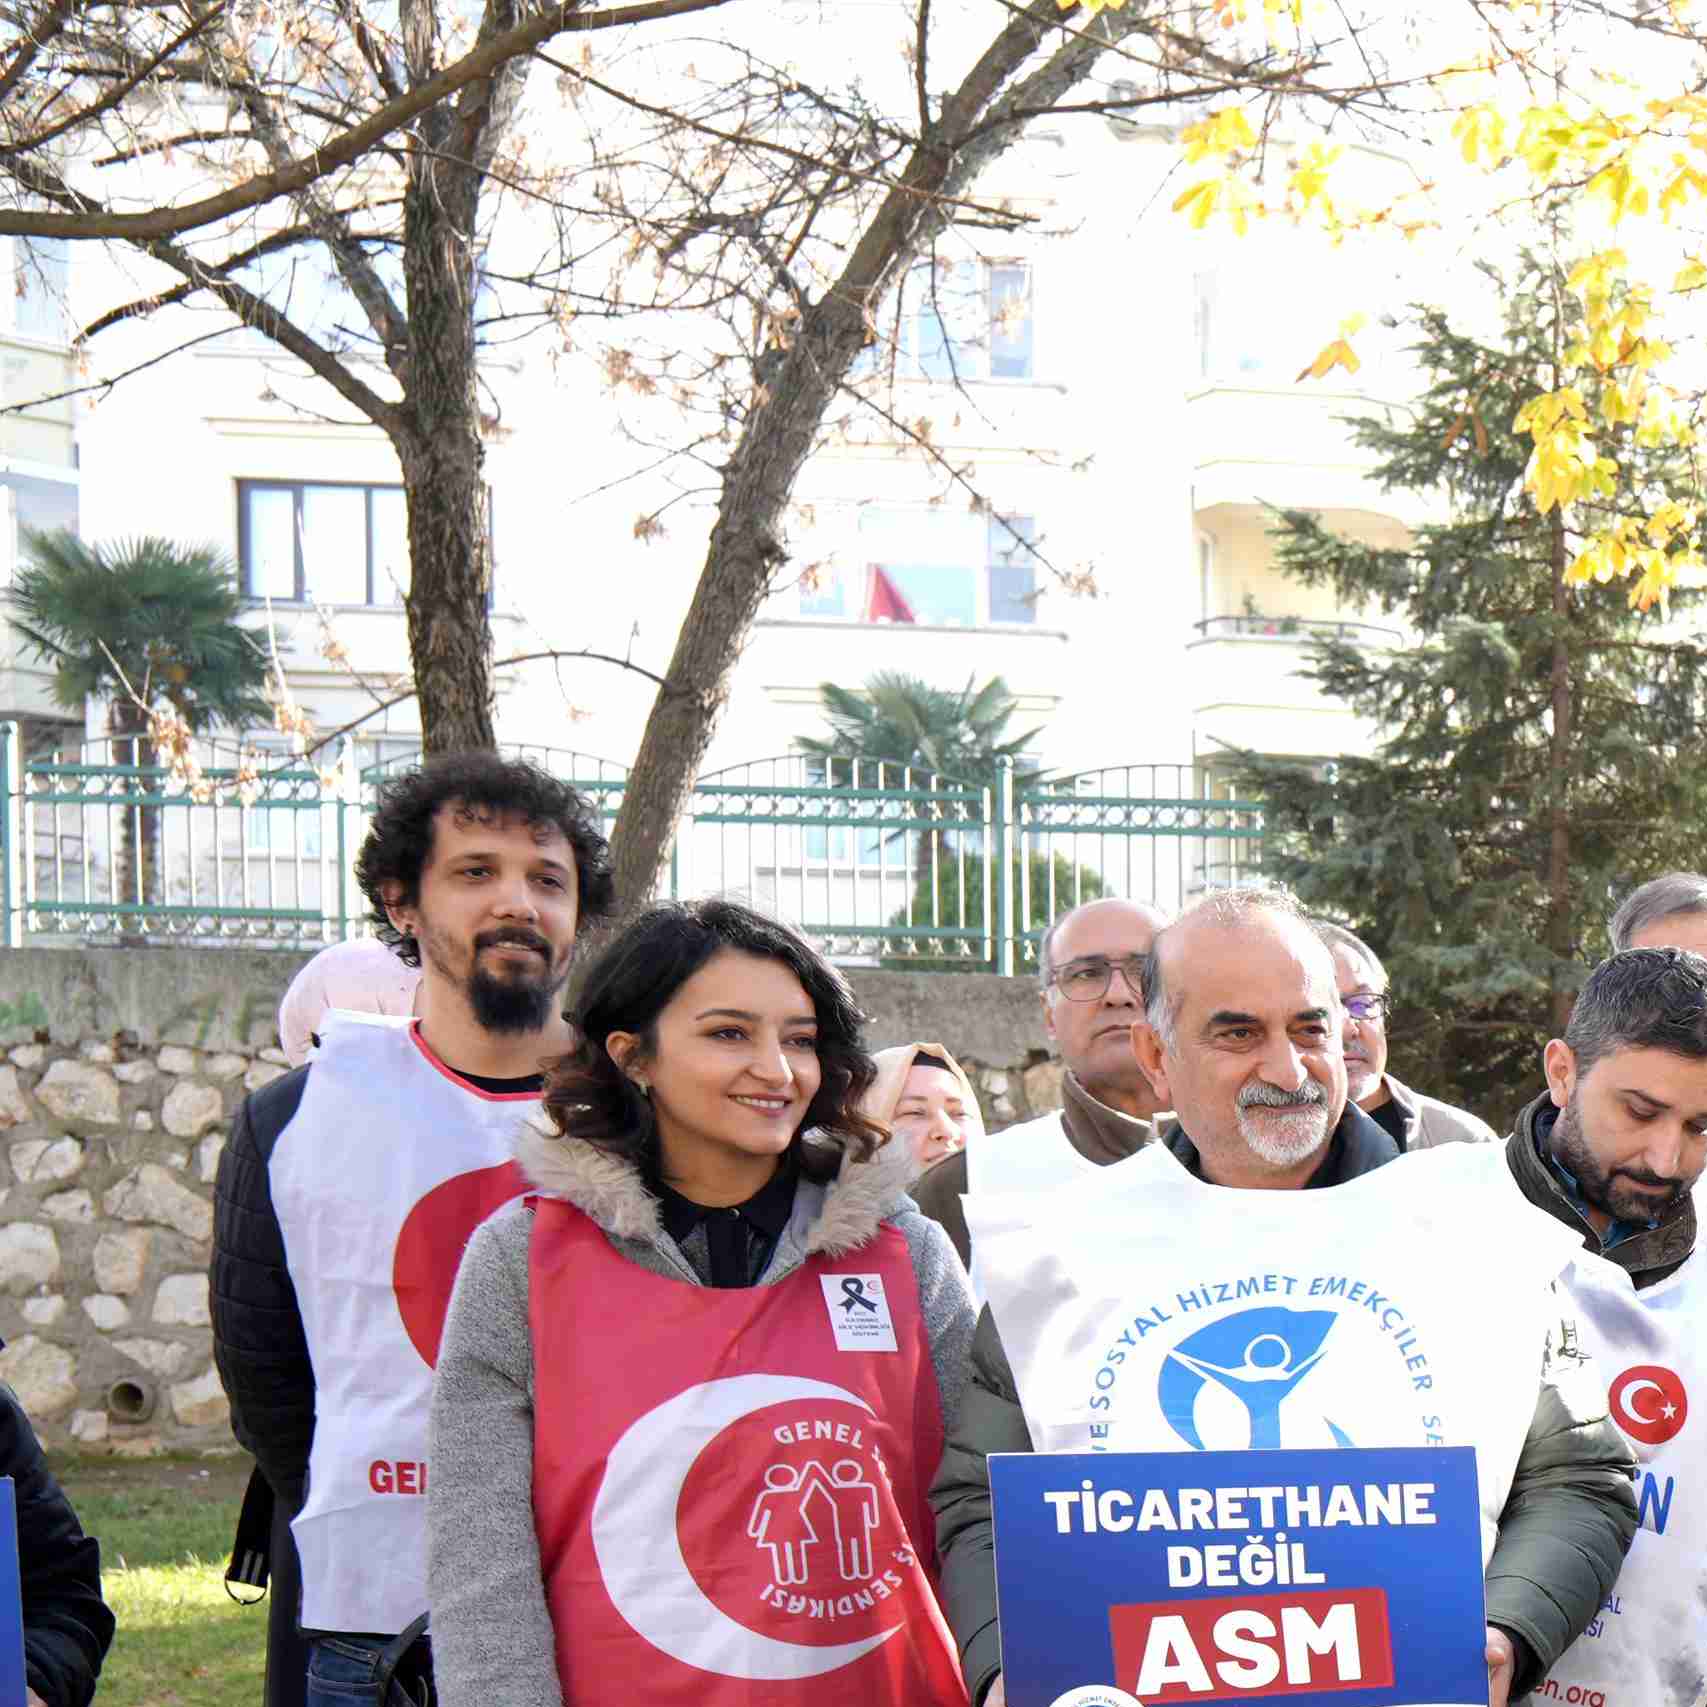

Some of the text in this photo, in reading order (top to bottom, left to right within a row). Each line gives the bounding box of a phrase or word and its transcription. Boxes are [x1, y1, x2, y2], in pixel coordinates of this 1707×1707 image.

[1089, 1304, 1173, 1411] SOSYAL
[1175, 1274, 1298, 1313] HİZMET
[774, 1420, 863, 1449] GENEL
[369, 1459, 426, 1495] GE
[1044, 1480, 1436, 1533] TİCARETHANE
[1168, 1533, 1325, 1587] DEĞİL
[760, 1569, 903, 1623] SENDİKASI
[1136, 1604, 1361, 1695] ASM
